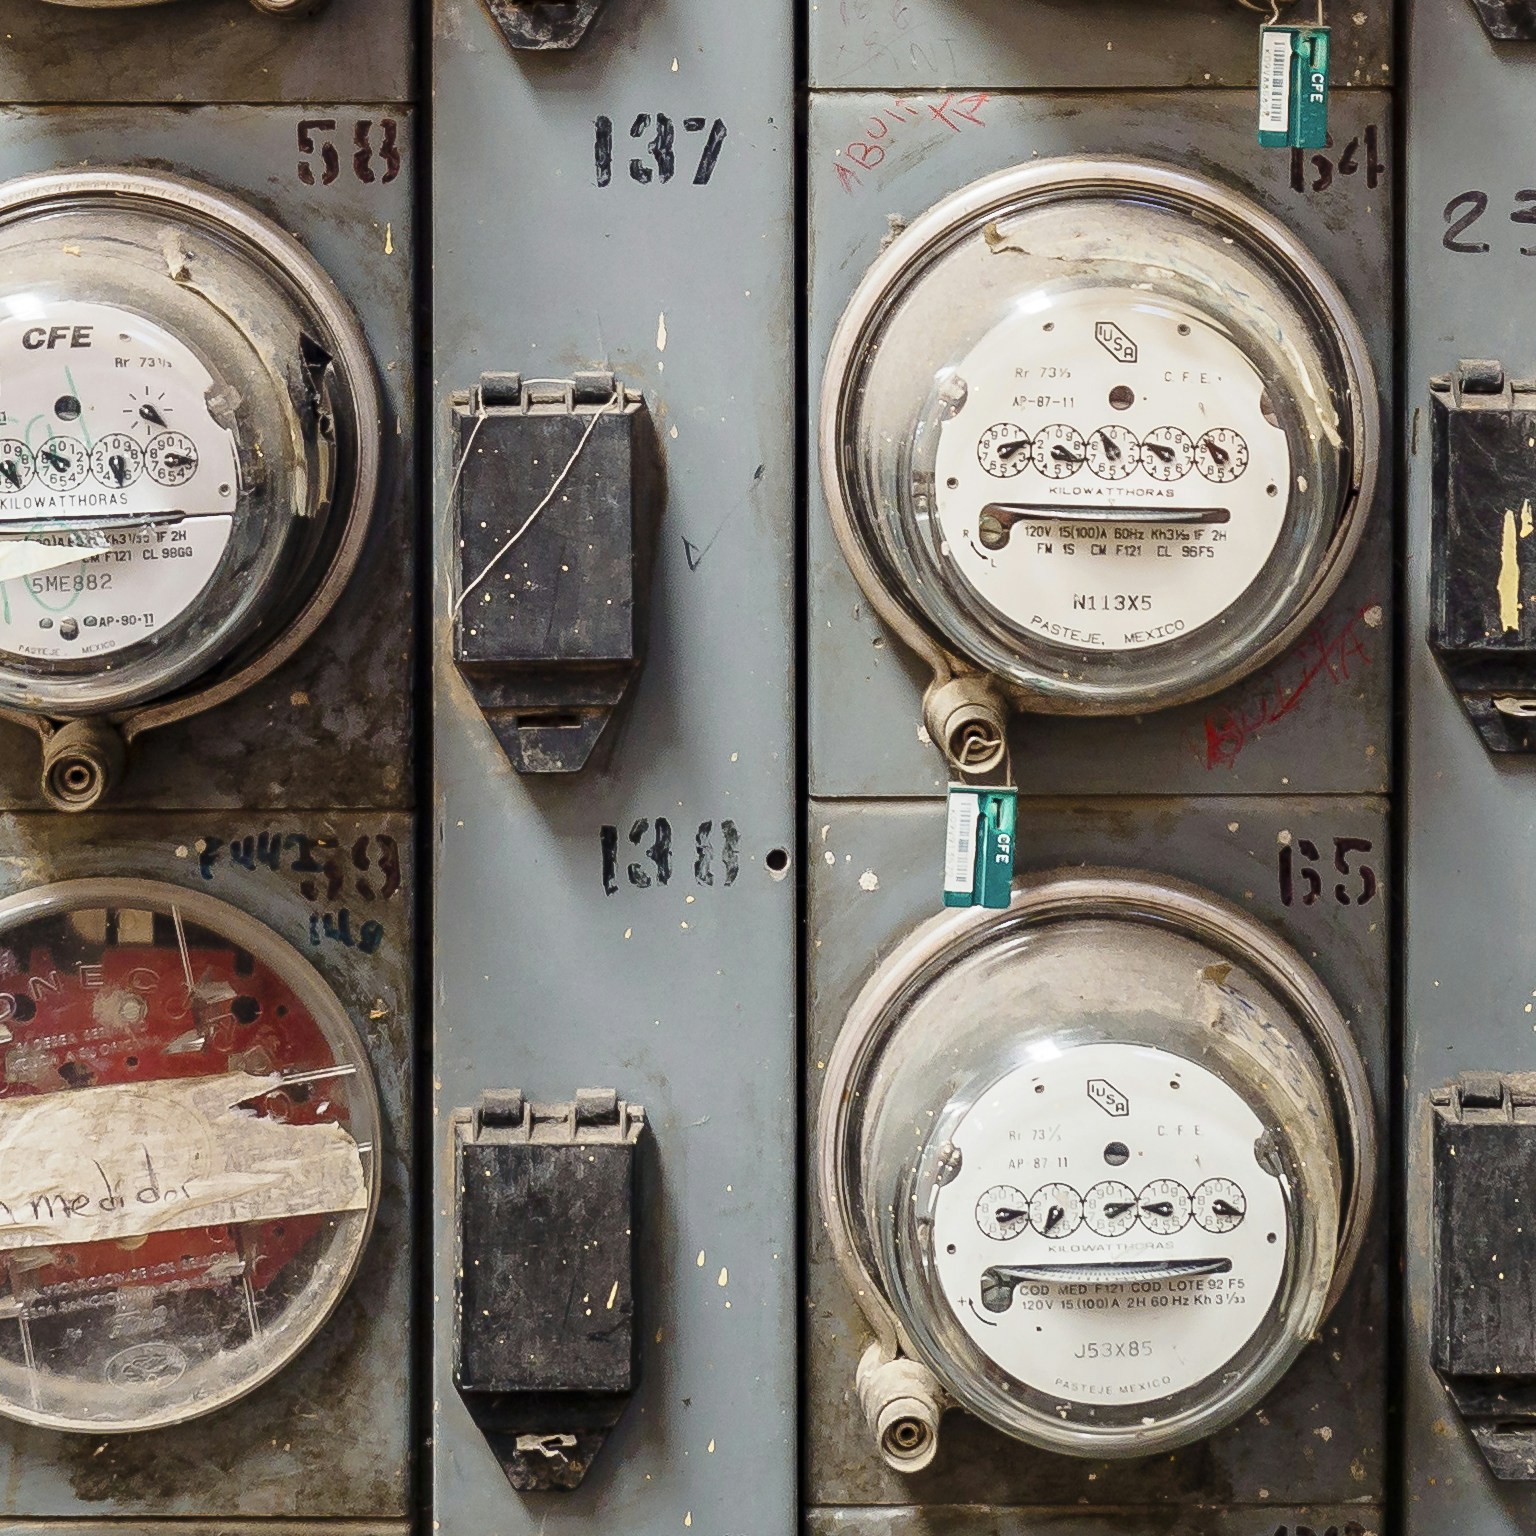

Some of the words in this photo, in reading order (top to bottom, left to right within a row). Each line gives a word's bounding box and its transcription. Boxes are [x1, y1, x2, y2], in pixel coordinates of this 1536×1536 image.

[1310, 72, 1323, 103] CFE
[295, 117, 400, 187] 58
[593, 113, 728, 189] 137
[22, 325, 94, 350] CFE
[1098, 325, 1134, 359] IUSA
[0, 493, 128, 511] KILOWATTHORAS
[1049, 487, 1175, 498] KILOWATTHORAS
[31, 573, 113, 593] 5ME882
[1124, 619, 1185, 644] MEXICO
[995, 833, 1010, 864] CFE
[1277, 835, 1378, 908] 65
[1091, 1083, 1127, 1113] IUSA
[1048, 1241, 1174, 1253] KILOWATTHORAS
[1074, 1341, 1154, 1360] J53X85
